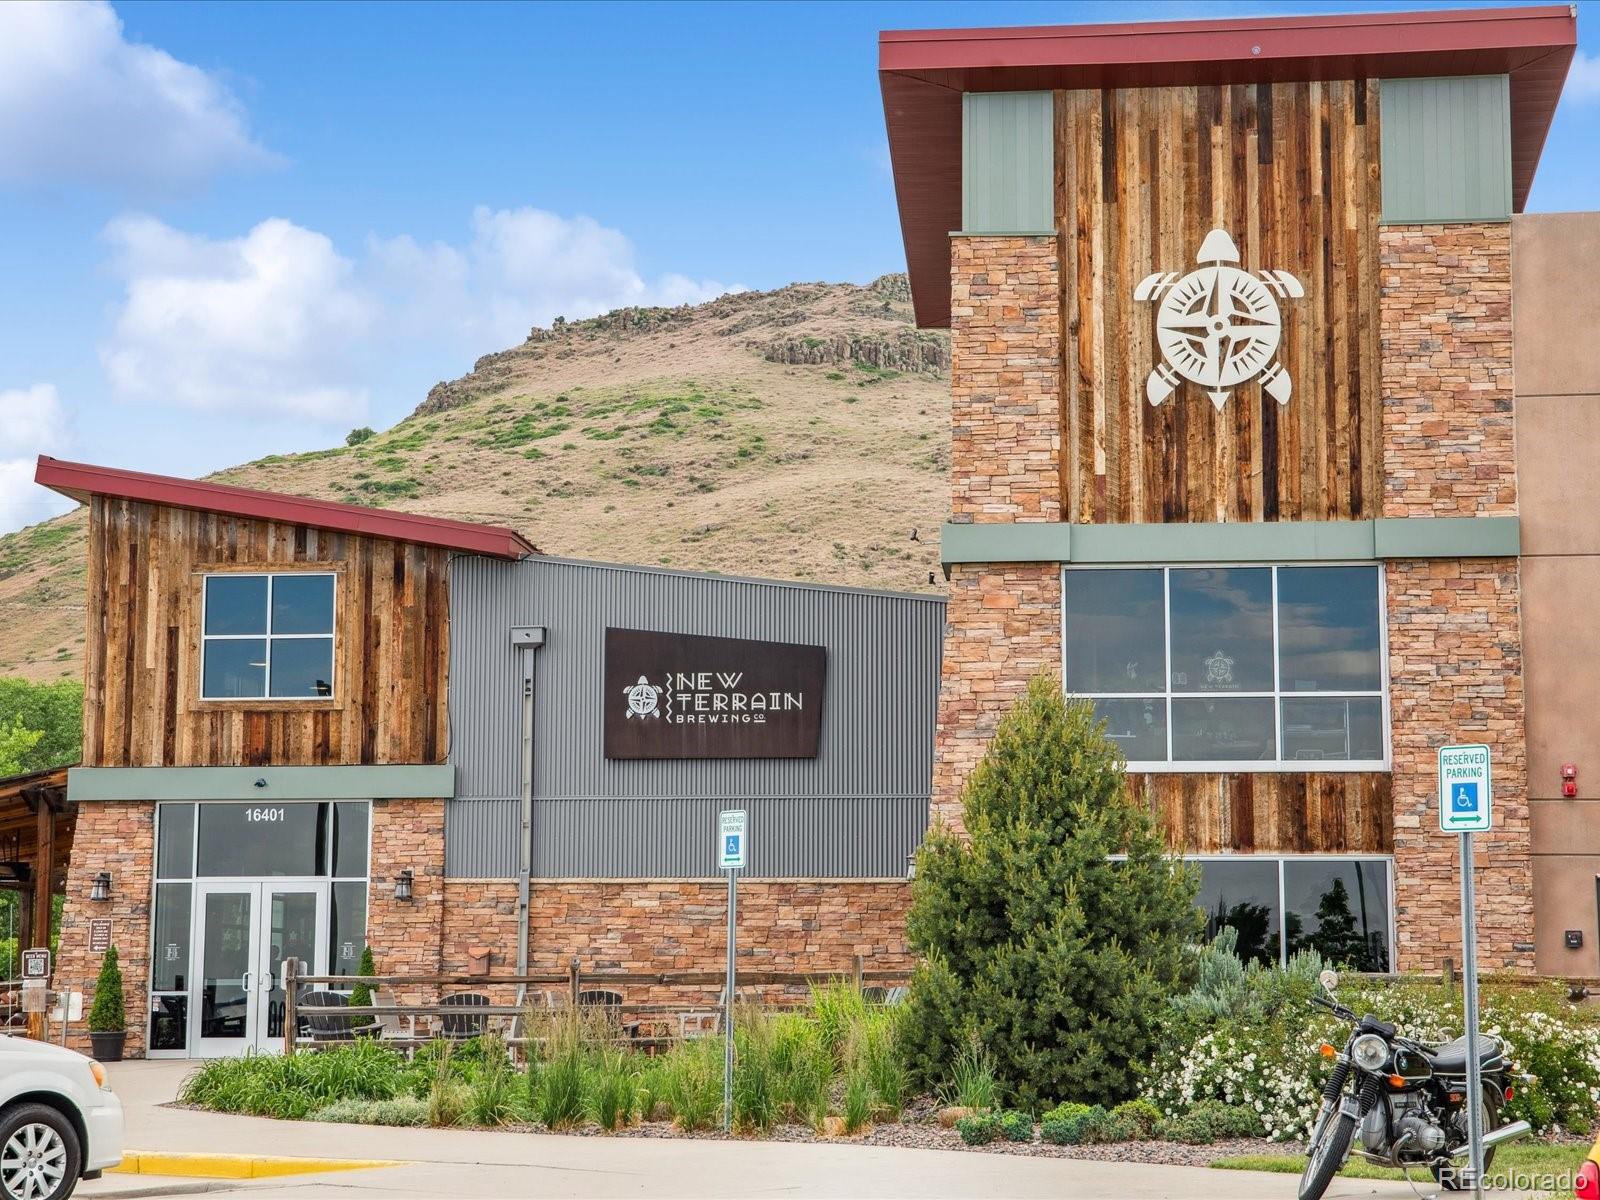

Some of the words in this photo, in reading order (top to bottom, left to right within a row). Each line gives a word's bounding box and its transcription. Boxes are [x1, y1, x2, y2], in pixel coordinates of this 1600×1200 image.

[677, 672, 743, 690] NEW
[677, 692, 803, 711] TERRAIN
[677, 714, 751, 724] BREWING
[1443, 753, 1485, 765] RESERVED
[1446, 767, 1483, 778] PARKING
[245, 808, 284, 822] 16401
[723, 824, 743, 833] PARKING
